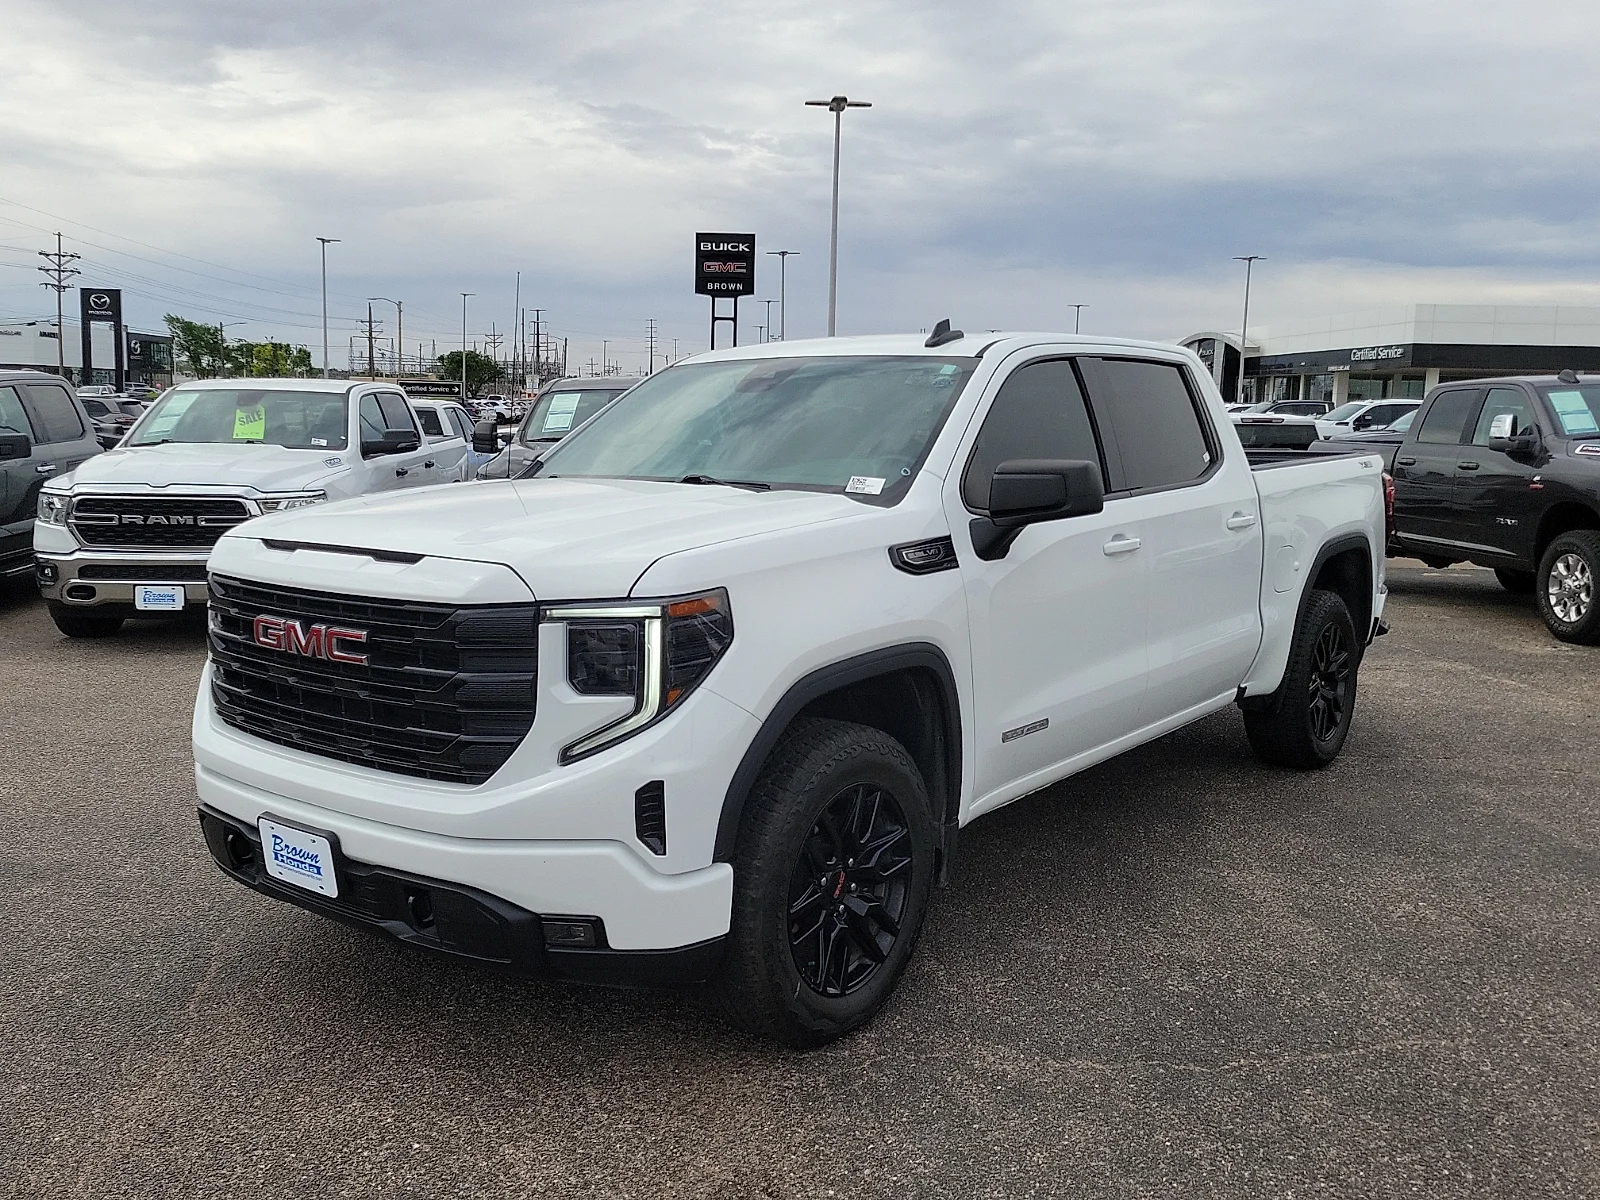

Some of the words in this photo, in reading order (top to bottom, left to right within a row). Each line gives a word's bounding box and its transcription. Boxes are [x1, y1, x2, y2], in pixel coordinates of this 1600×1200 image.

[700, 242, 750, 251] BUICK
[703, 262, 747, 273] GMC
[707, 282, 743, 290] BROWN
[1350, 347, 1378, 361] Certified
[1377, 345, 1405, 360] Service
[402, 385, 428, 393] Certified
[428, 385, 450, 393] Service
[238, 410, 264, 426] SALE
[121, 515, 194, 525] RAM
[143, 590, 176, 599] Brown
[253, 614, 369, 666] GMC
[271, 833, 321, 864] Brown
[278, 854, 318, 874] Honda
